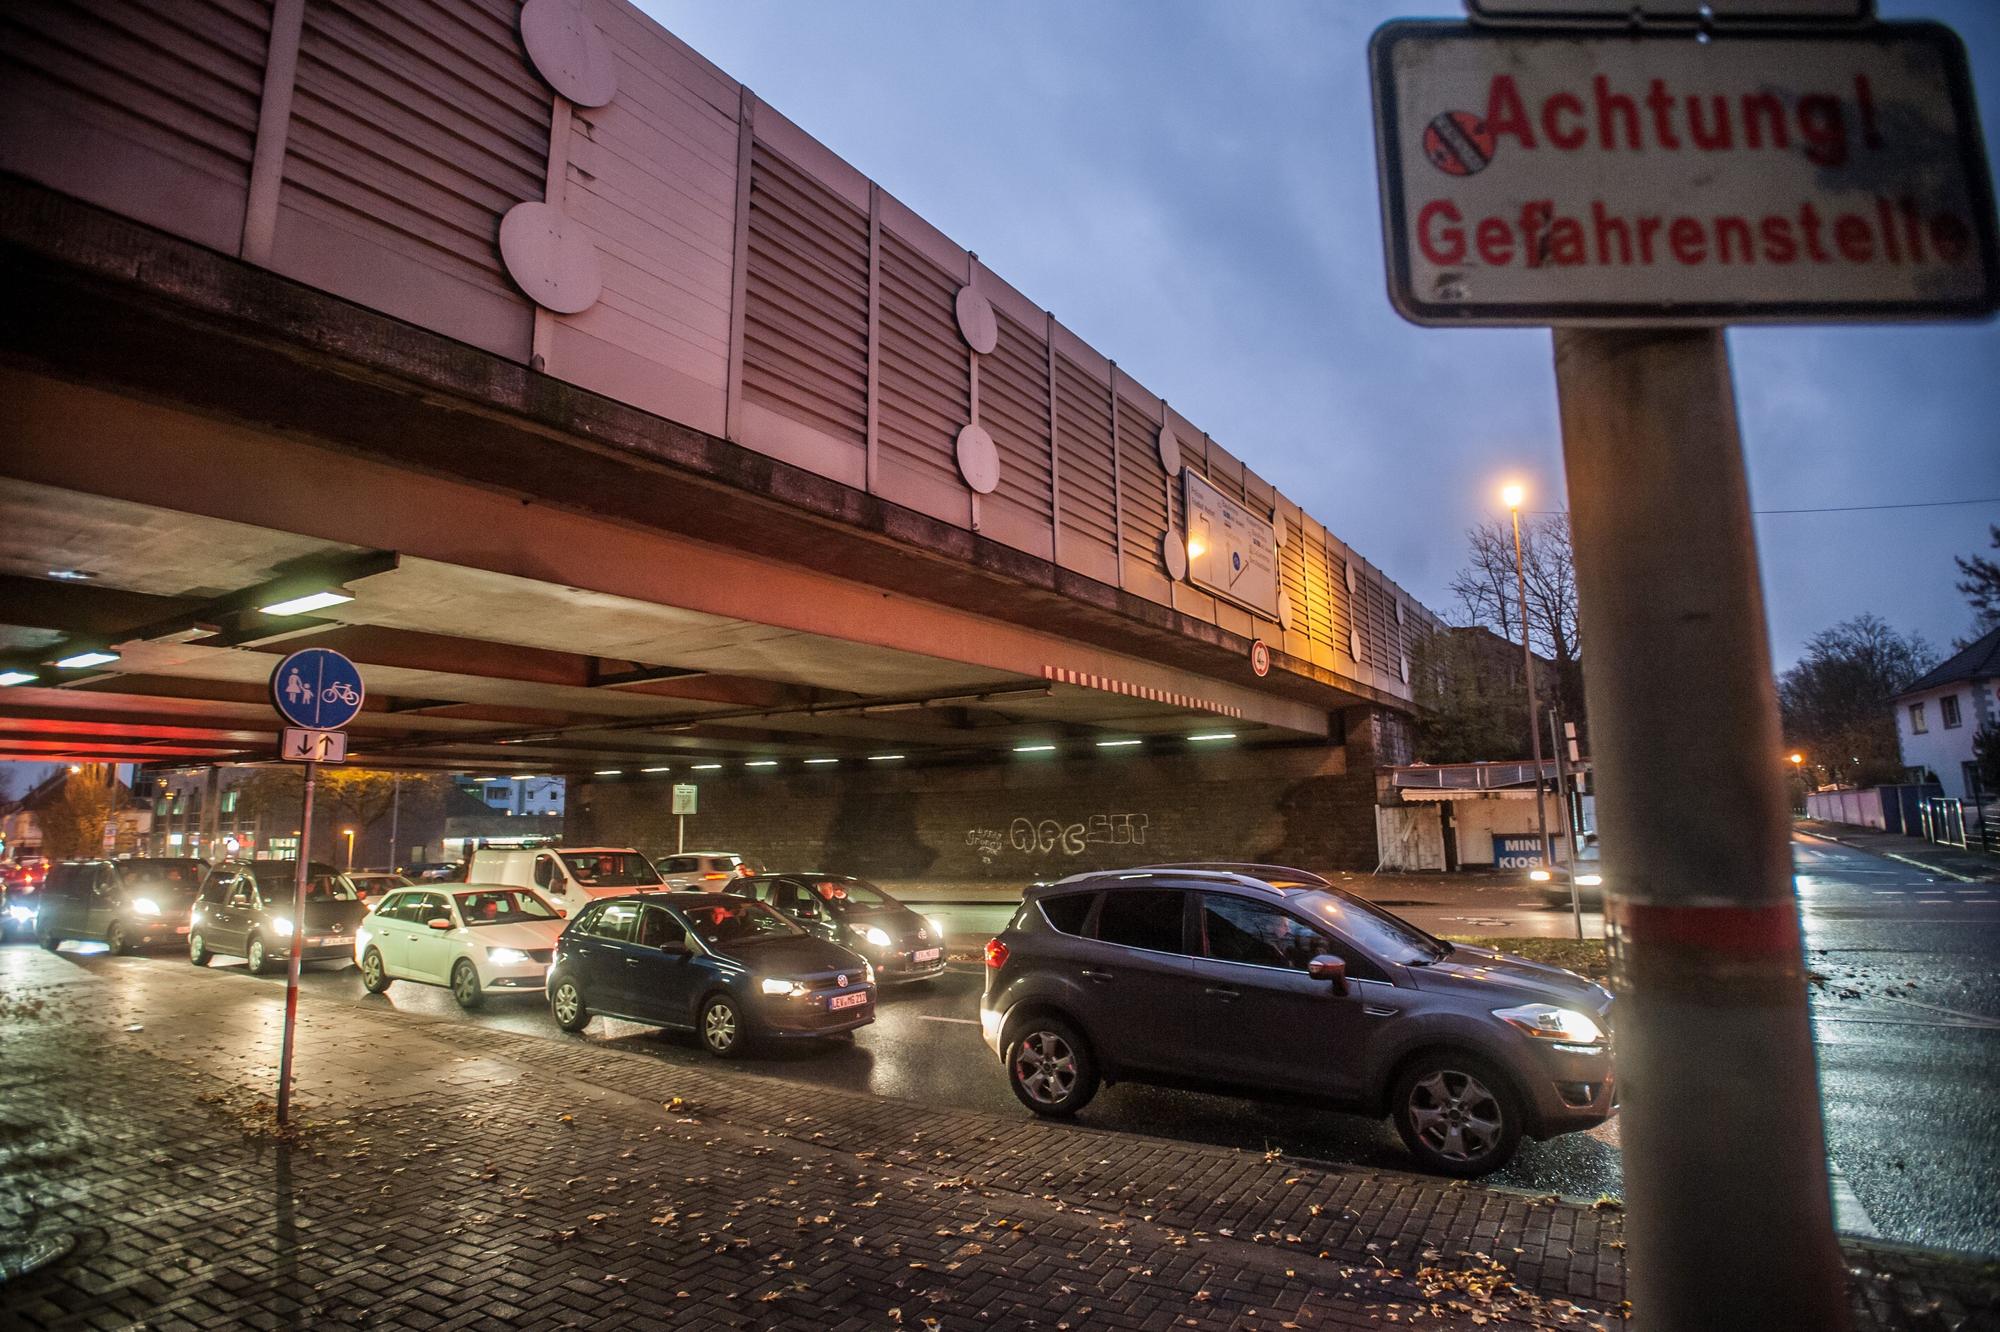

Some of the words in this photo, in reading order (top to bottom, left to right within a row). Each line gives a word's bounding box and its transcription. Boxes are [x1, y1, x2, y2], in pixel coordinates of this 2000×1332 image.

[1481, 73, 1884, 169] Achtung!
[1417, 194, 1972, 268] Gefahrenstelle
[1504, 839, 1542, 851] MINI
